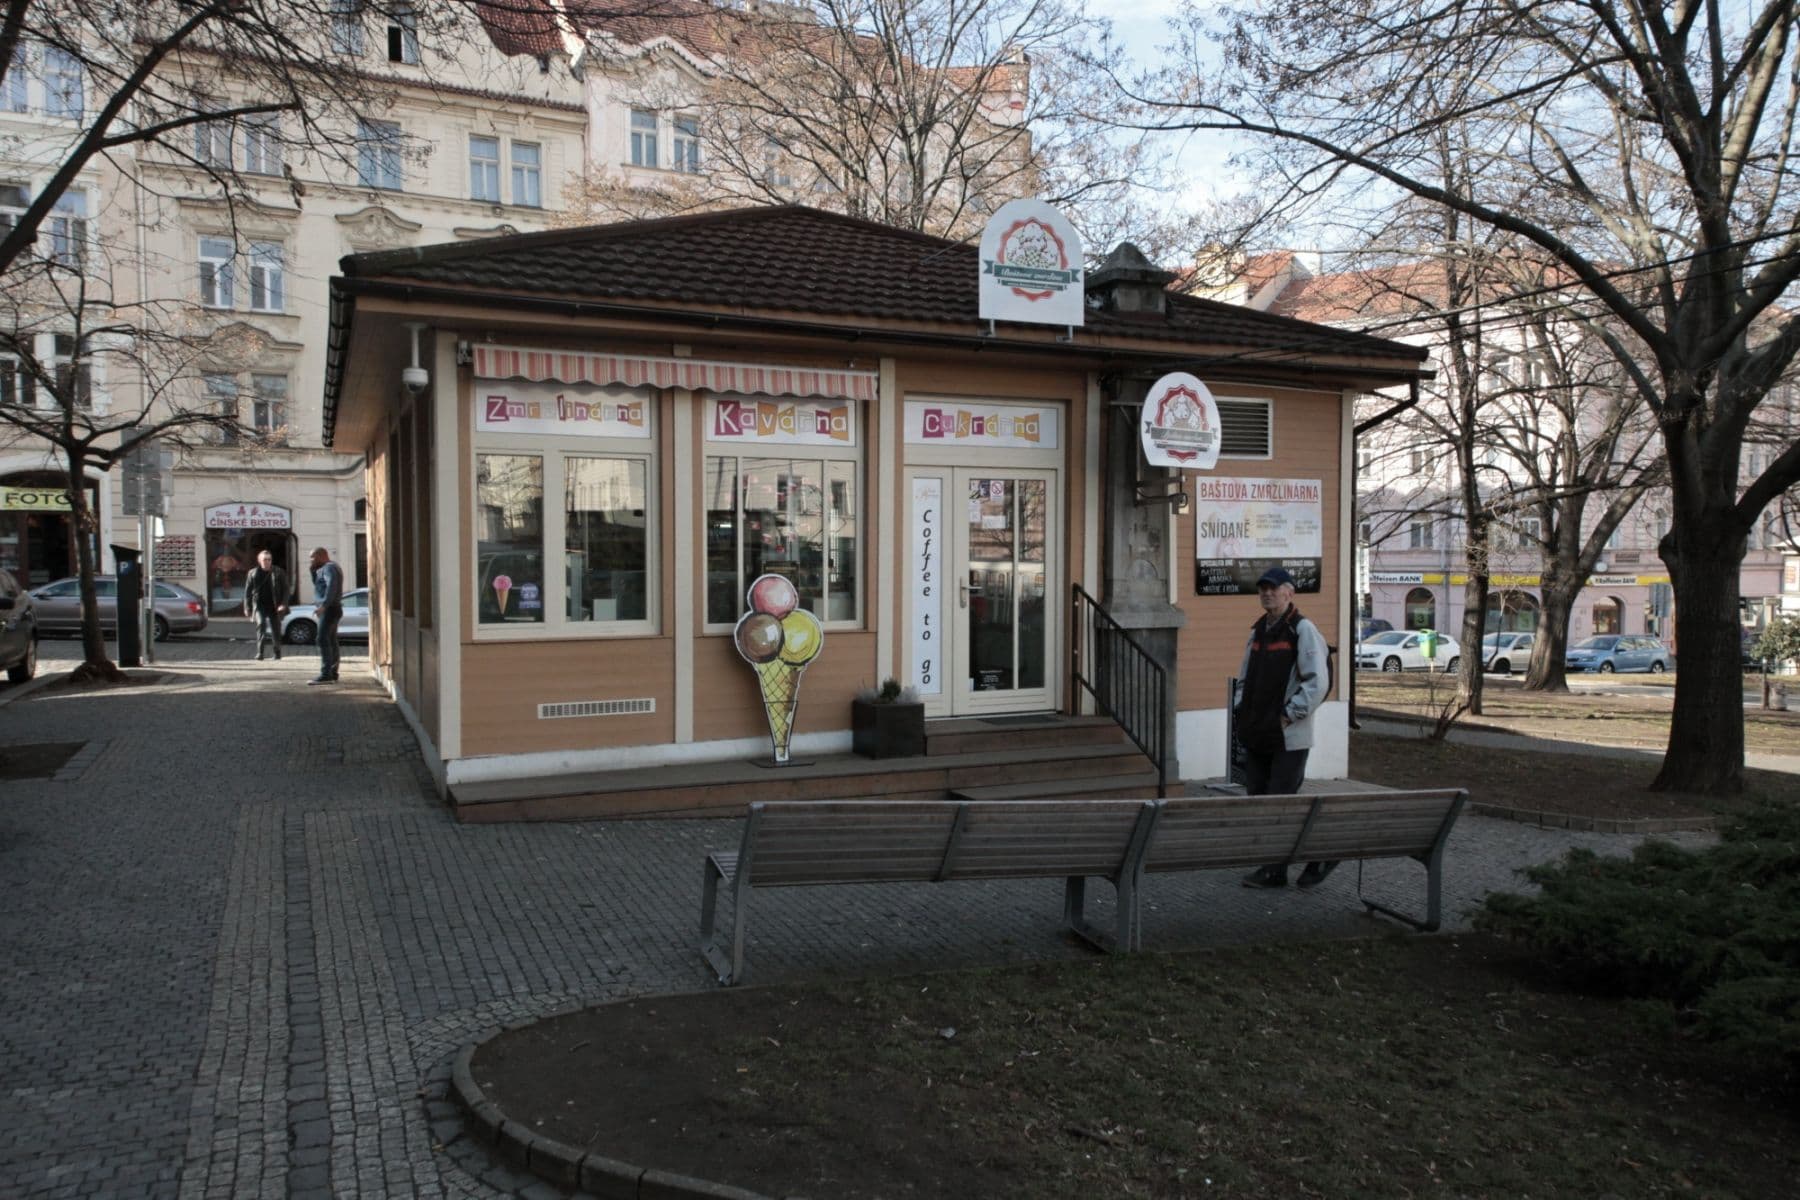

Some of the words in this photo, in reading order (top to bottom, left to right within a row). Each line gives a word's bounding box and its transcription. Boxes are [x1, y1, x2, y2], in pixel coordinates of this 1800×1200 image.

[714, 400, 850, 441] Kavárna
[922, 409, 1040, 442] Cukrárna
[5, 493, 73, 505] FOTO
[1200, 480, 1248, 498] BAŠTOVA
[1250, 482, 1319, 500] ZMRZLINÁRNA
[209, 517, 248, 527] ČÍNSKÉ
[250, 518, 288, 527] BISTRO
[1200, 519, 1251, 539] SNÍDANĚ
[921, 509, 933, 598] Coffee
[923, 613, 932, 641] to
[922, 658, 931, 685] go
